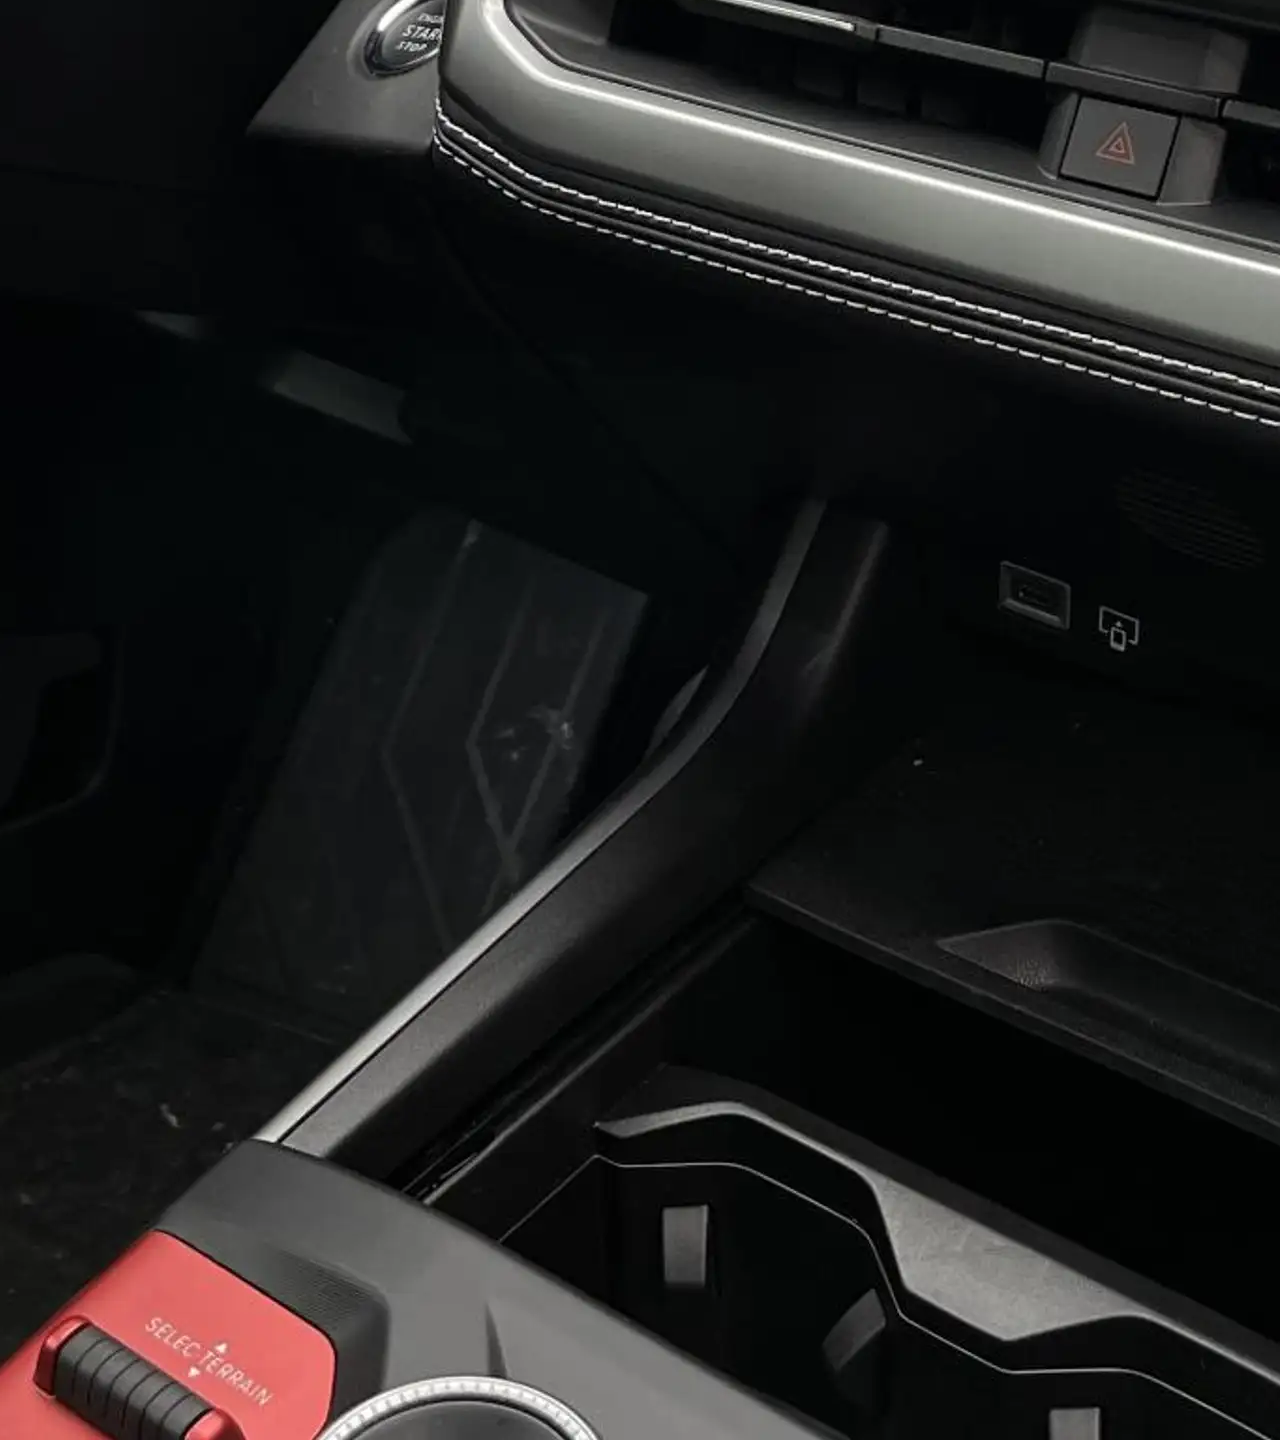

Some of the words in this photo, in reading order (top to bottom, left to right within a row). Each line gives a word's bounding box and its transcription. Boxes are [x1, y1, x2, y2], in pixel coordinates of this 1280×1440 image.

[402, 24, 443, 41] STAR
[395, 40, 428, 53] STOP
[144, 1316, 202, 1358] SELEC
[198, 1349, 276, 1407] TERRAIN
